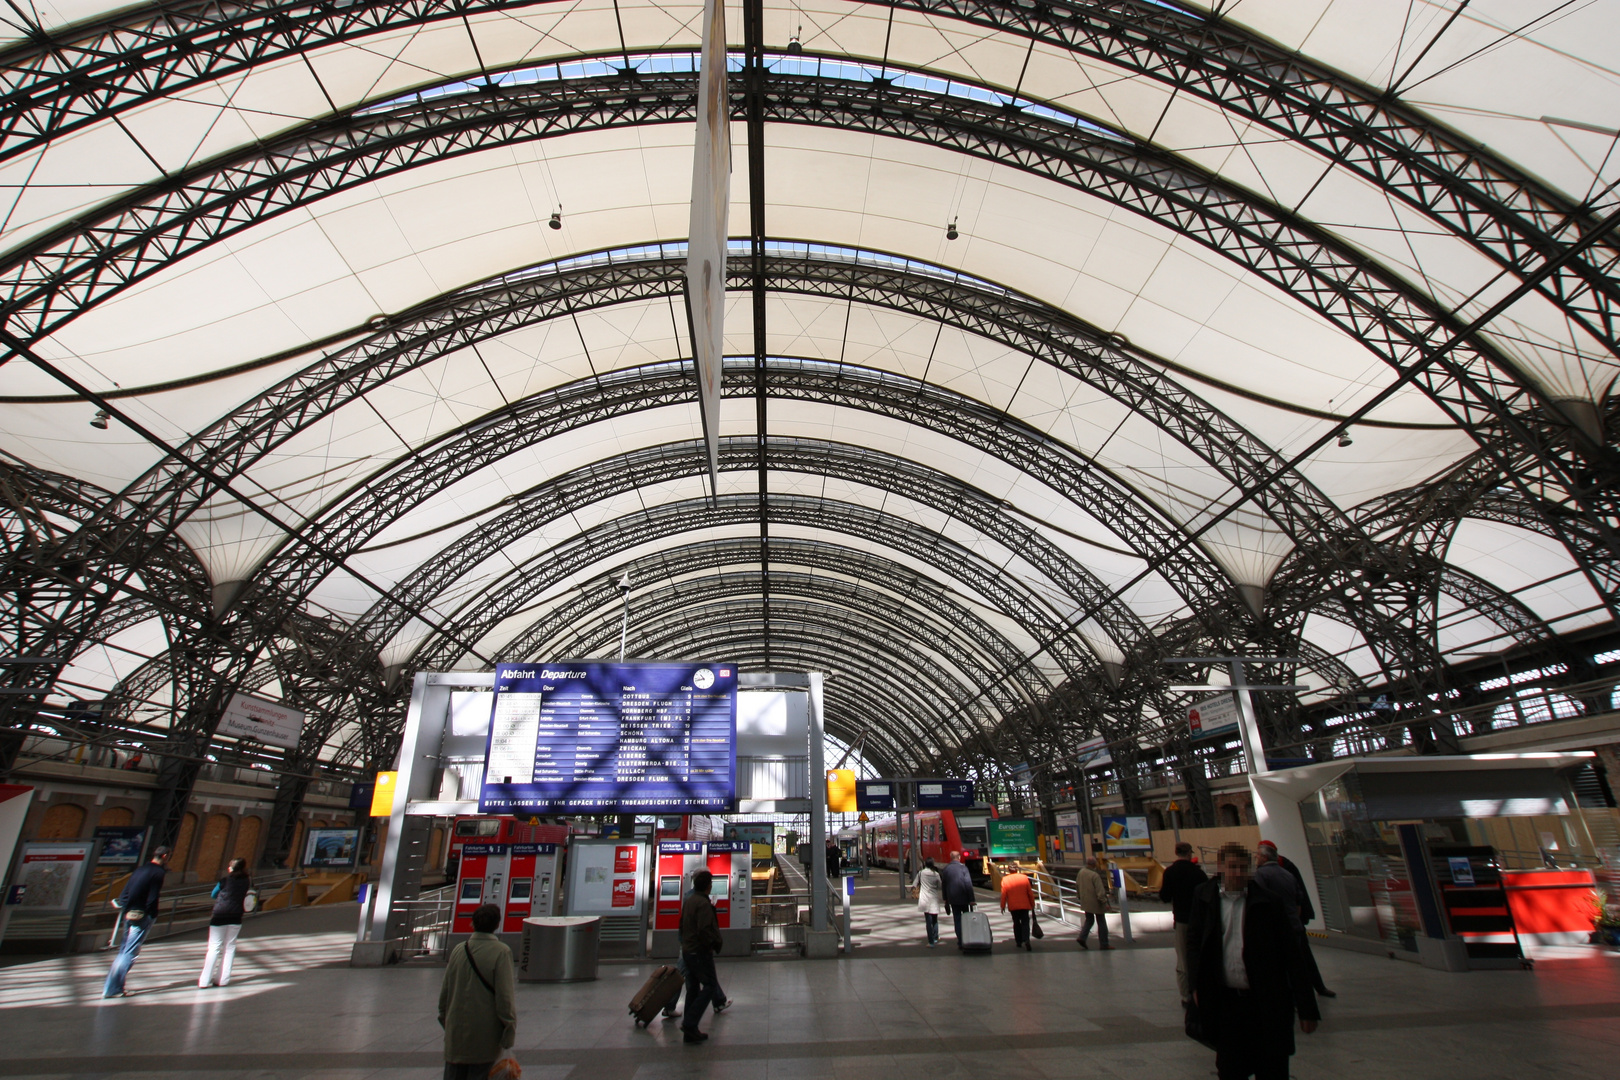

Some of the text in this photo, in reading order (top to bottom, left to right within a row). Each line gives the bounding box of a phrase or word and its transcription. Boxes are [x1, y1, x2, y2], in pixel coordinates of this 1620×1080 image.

[501, 669, 586, 680] Abfahrt Departure
[241, 701, 287, 720] Kunstsammlungen
[959, 785, 967, 793] 12
[521, 938, 531, 972] Abfall
